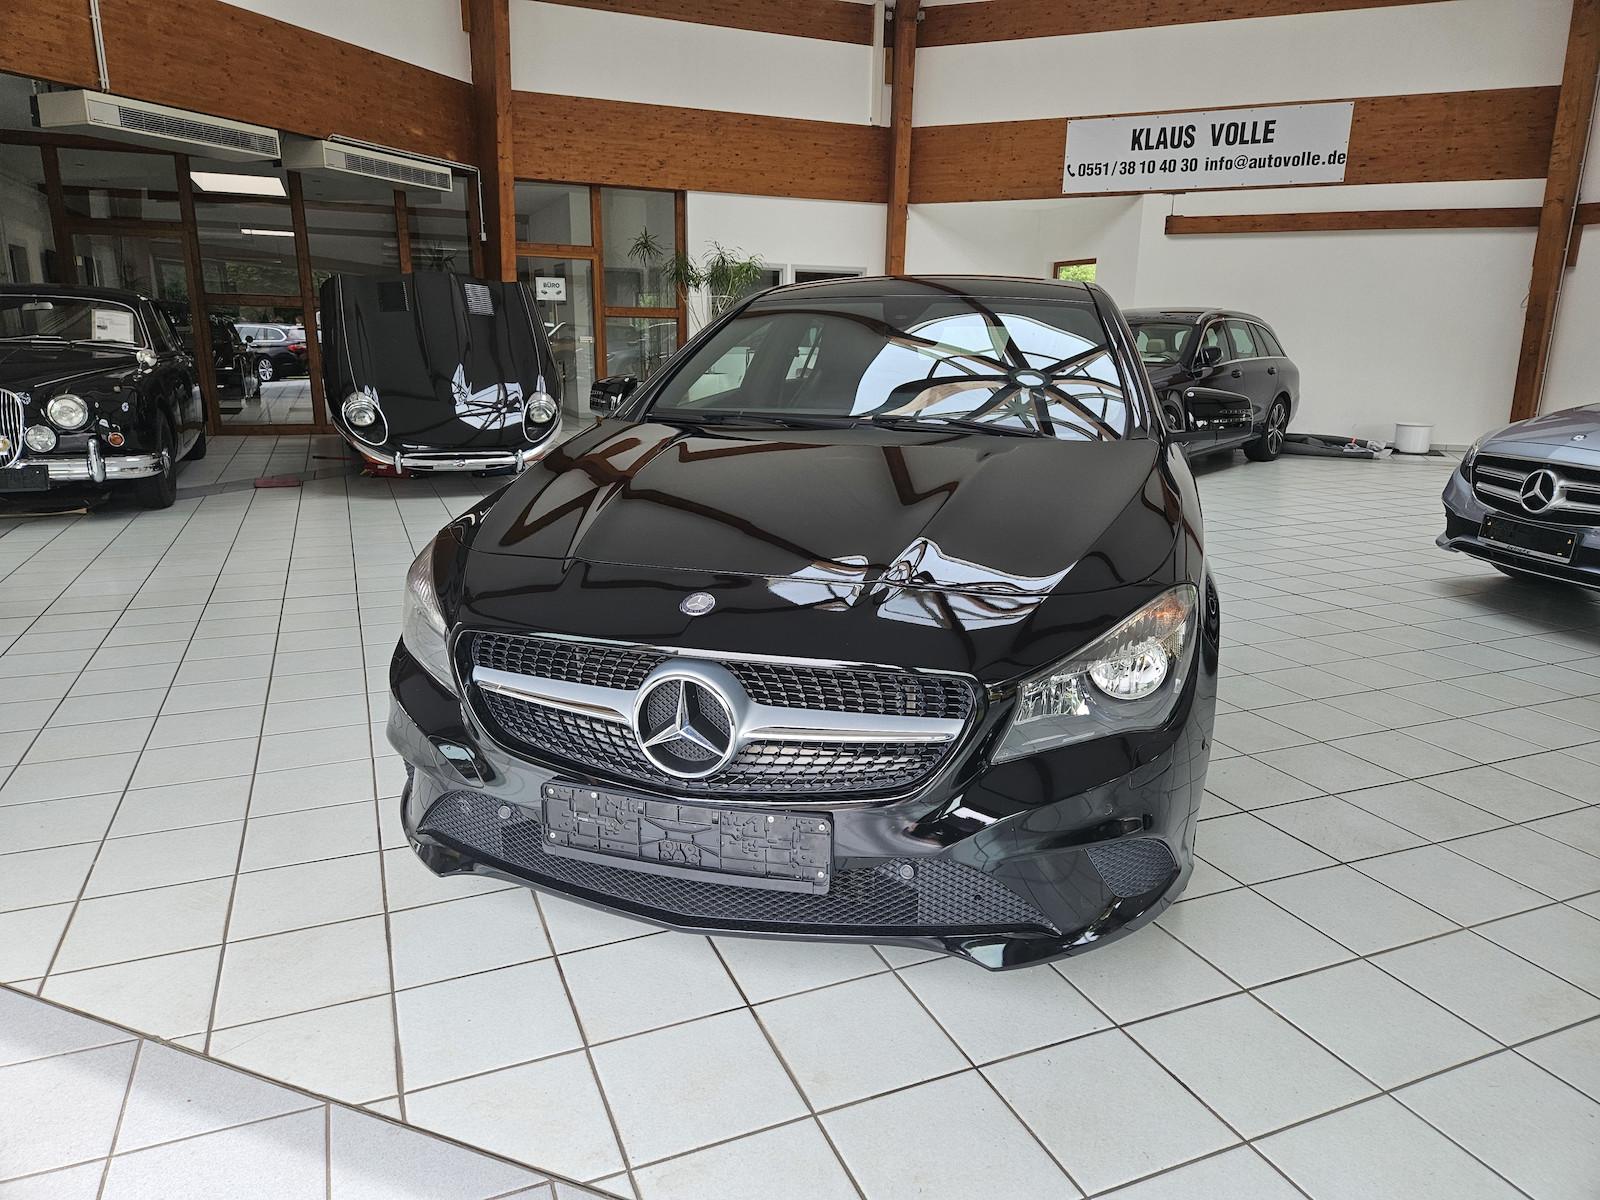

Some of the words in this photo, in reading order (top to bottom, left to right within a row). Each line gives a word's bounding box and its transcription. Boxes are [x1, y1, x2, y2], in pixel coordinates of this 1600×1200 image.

[1130, 124, 1196, 151] KLAUS
[1211, 119, 1277, 147] VOLLE
[1139, 160, 1156, 174] 10
[1159, 159, 1177, 173] 40
[1180, 158, 1198, 172] 30
[1204, 150, 1346, 171] info@autovolle.de
